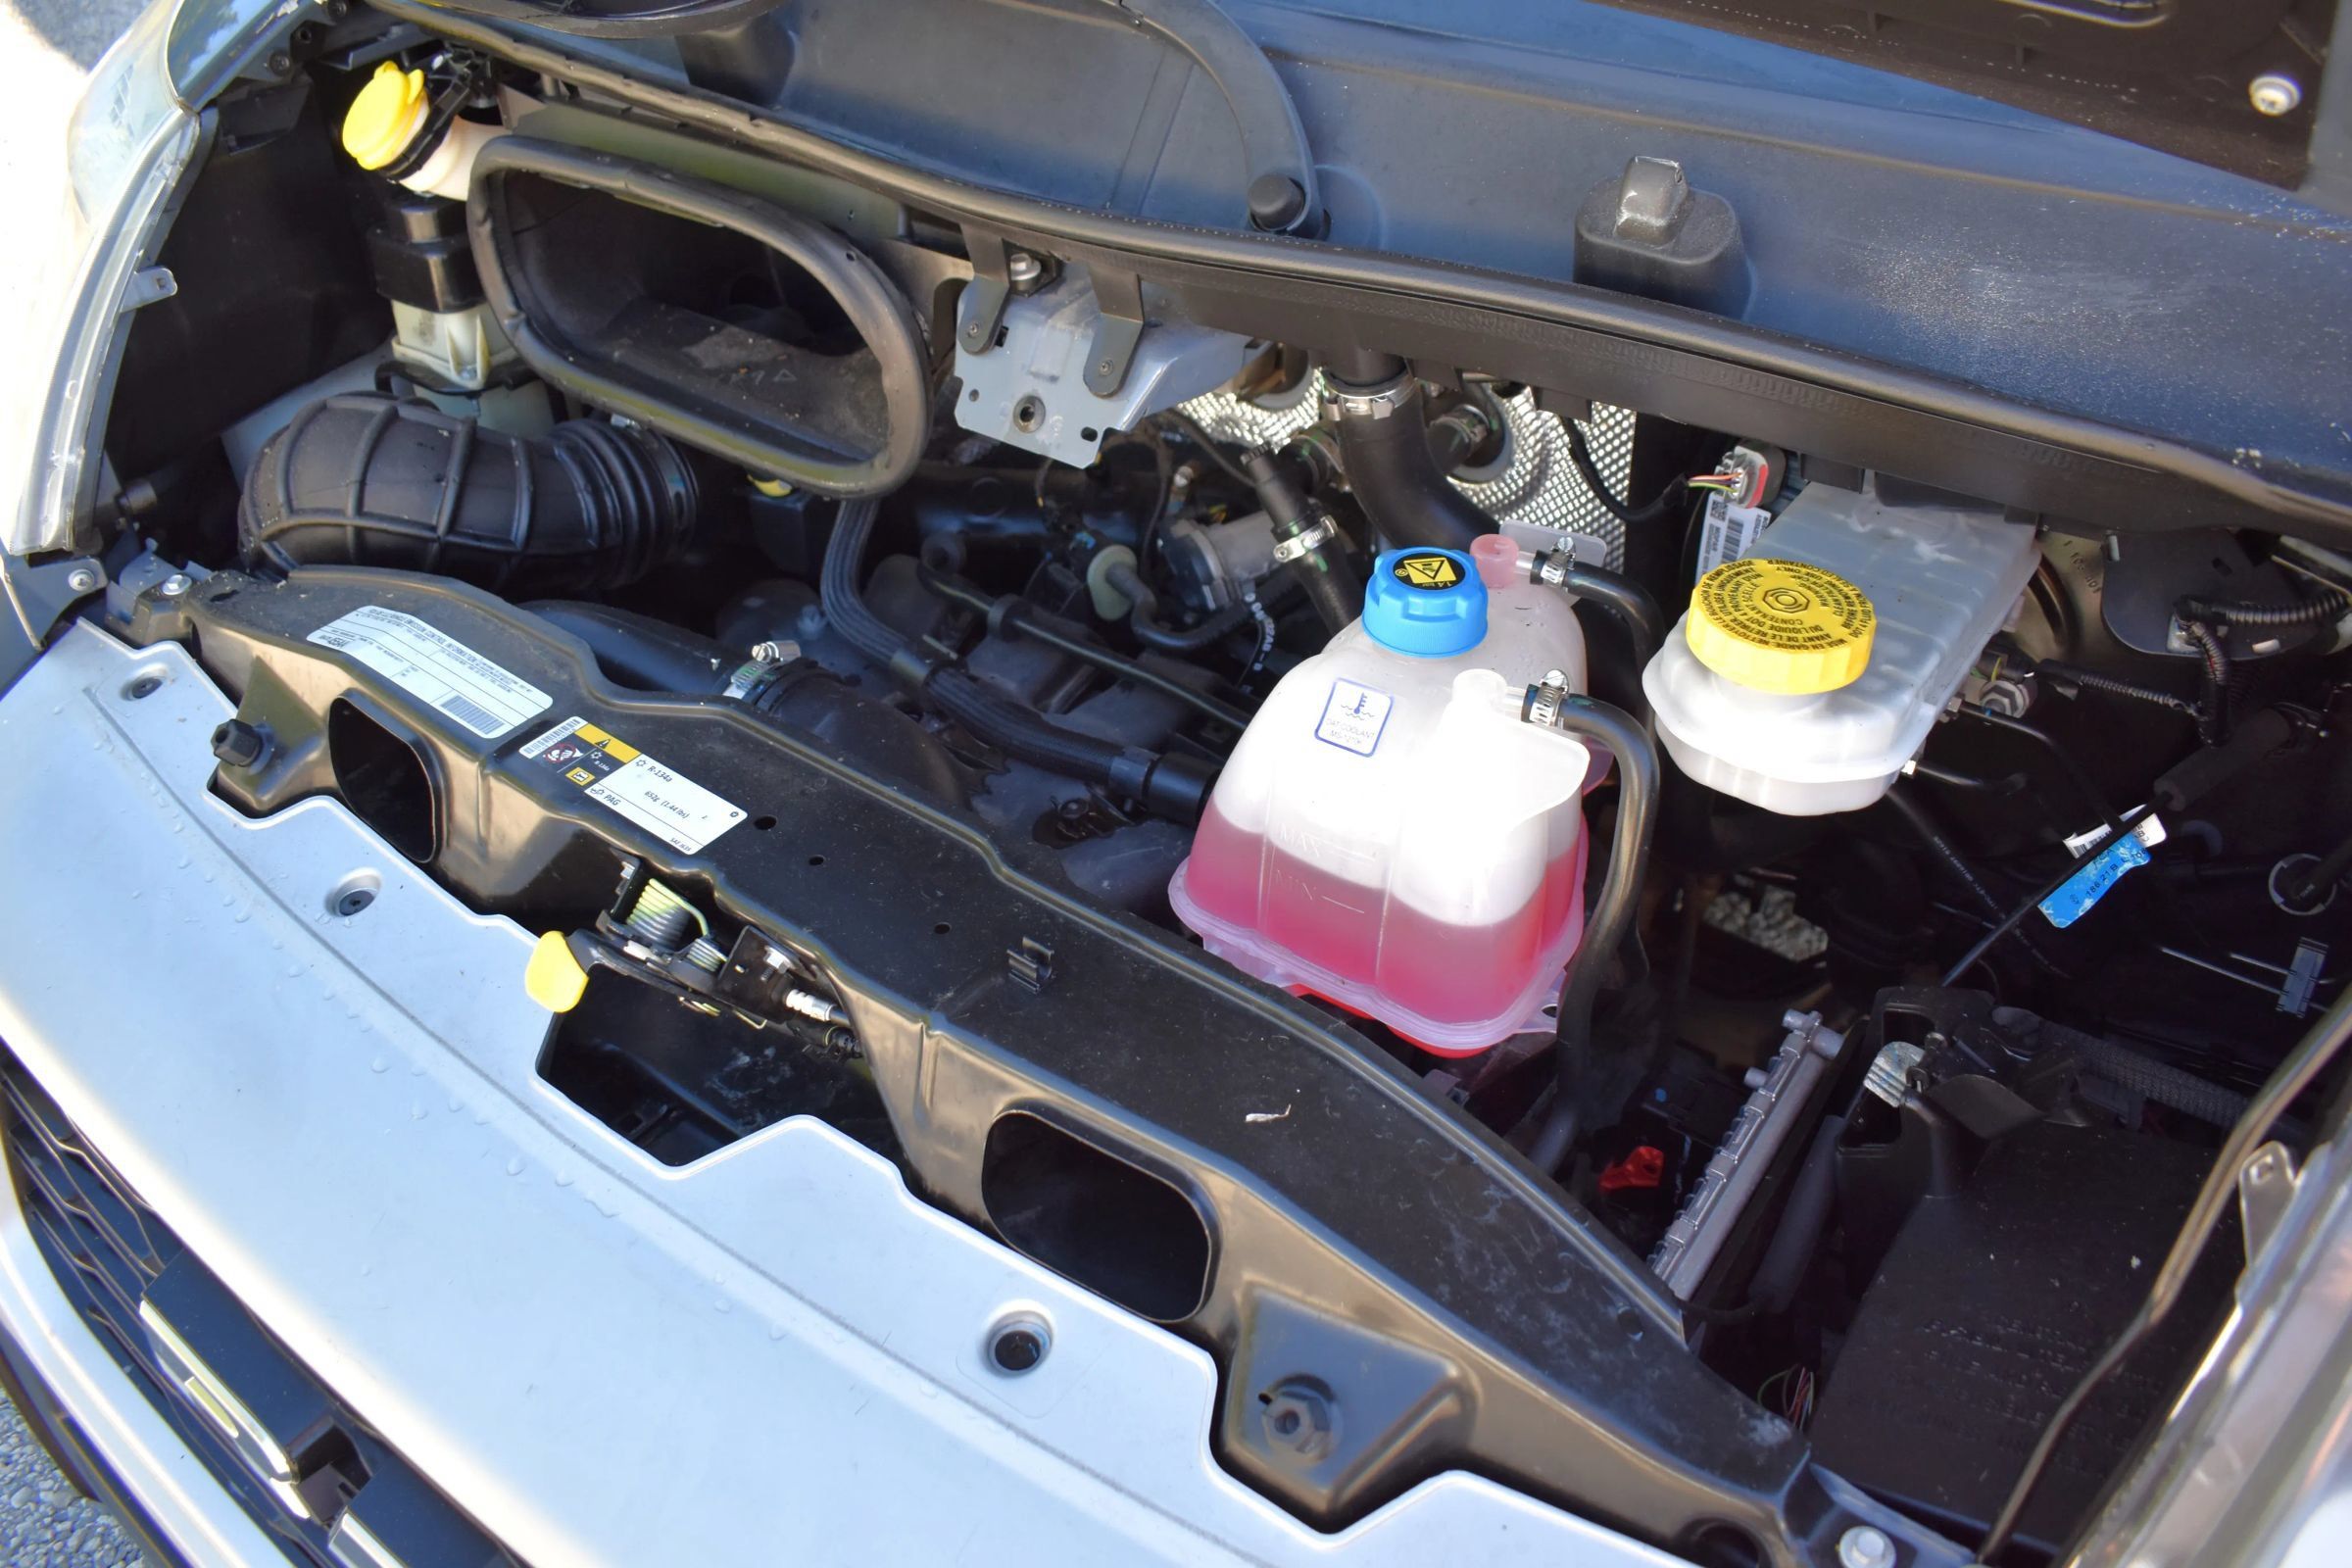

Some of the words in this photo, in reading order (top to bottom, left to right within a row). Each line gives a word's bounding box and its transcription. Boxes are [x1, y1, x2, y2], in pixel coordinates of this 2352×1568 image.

[1706, 560, 1755, 582] REMPLISSAGE
[1717, 567, 1757, 592] UNIQUEMENT
[1804, 571, 1823, 580] USE
[1821, 569, 1854, 588] SEALED
[1701, 581, 1714, 590] DE
[1811, 581, 1838, 598] FILLER
[1700, 589, 1719, 617] BOUCHON
[1714, 592, 1732, 616] UTILISER
[1728, 580, 1744, 612] PROVENANT
[1853, 593, 1871, 608] FROM
[1744, 604, 1804, 626] CONTENANT
[1833, 599, 1844, 617] CLEAN
[1859, 609, 1872, 624] FLUID
[1714, 616, 1726, 627] LE
[1745, 616, 1766, 627] DOT
[1840, 608, 1857, 629] BEFORE
[1722, 623, 1769, 646] NETTOYER
[1769, 624, 1808, 634] LIQUIDE
[1771, 632, 1784, 641] LE
[1803, 632, 1832, 643] AVANT
[1808, 624, 1825, 633] DU
[1849, 626, 1865, 638] DOT
[648, 765, 672, 783] R-134a
[604, 794, 621, 806] PAG
[644, 790, 661, 803] 652g
[661, 800, 678, 813] (1.44
[676, 808, 691, 819] lbs)
[1278, 821, 1320, 858] MAX
[1276, 869, 1316, 901] MIN
